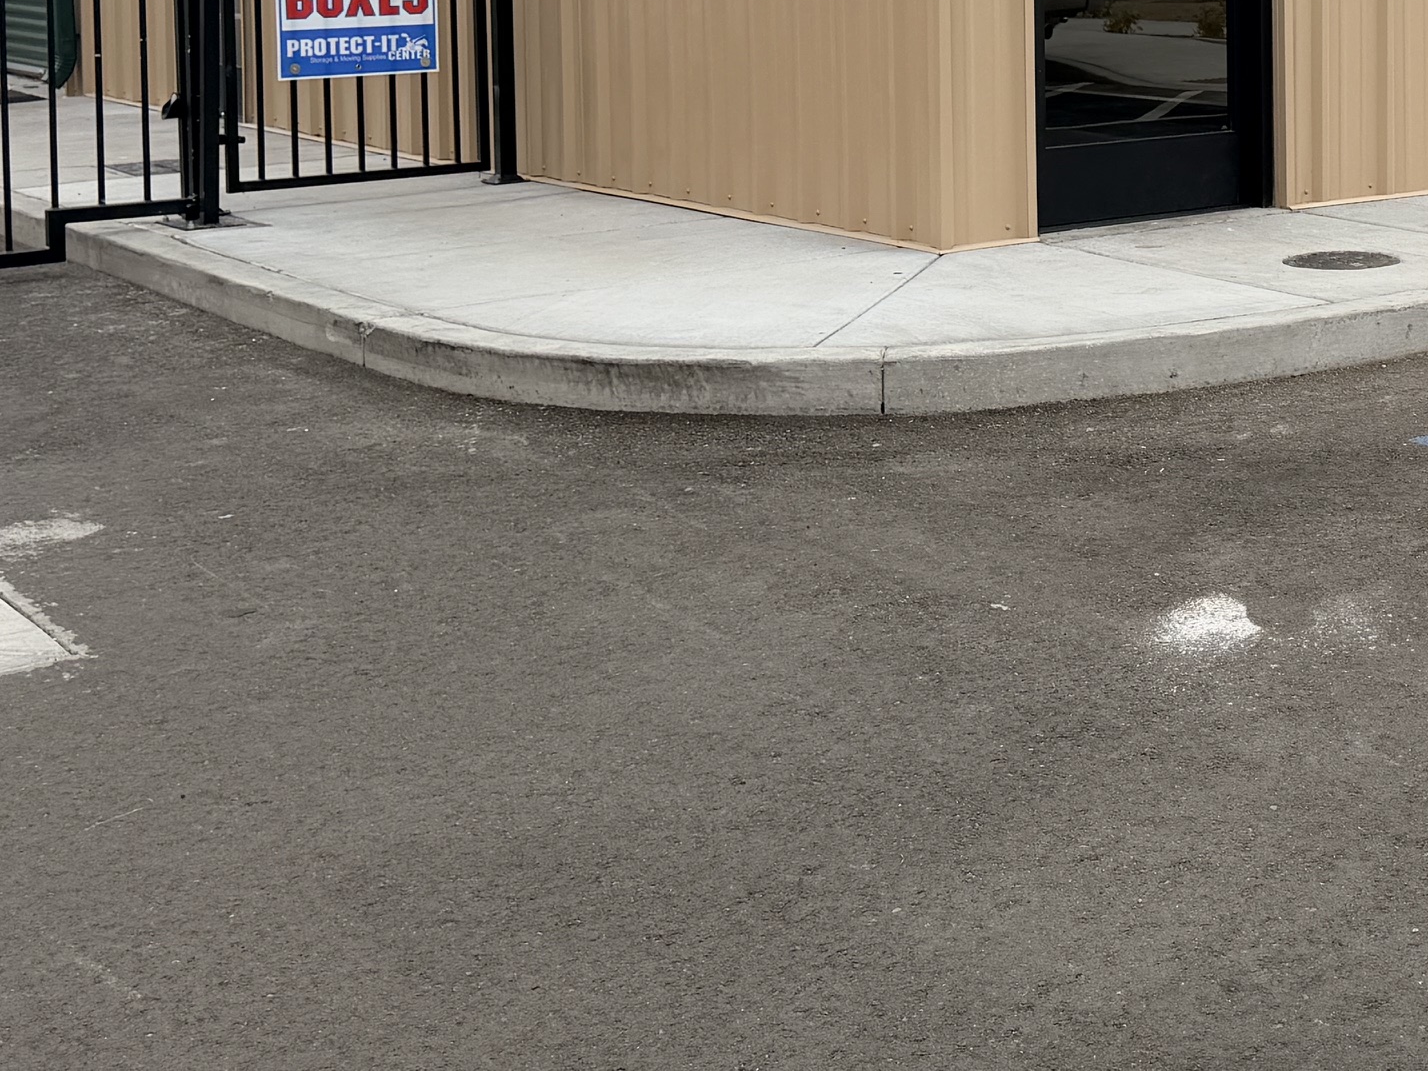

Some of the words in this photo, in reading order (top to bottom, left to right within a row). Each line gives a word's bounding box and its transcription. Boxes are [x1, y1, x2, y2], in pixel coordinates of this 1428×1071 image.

[286, 34, 399, 58] PROTECT-IT
[310, 56, 333, 64] Storage
[340, 54, 361, 62] Moving
[388, 48, 431, 61] CENTER
